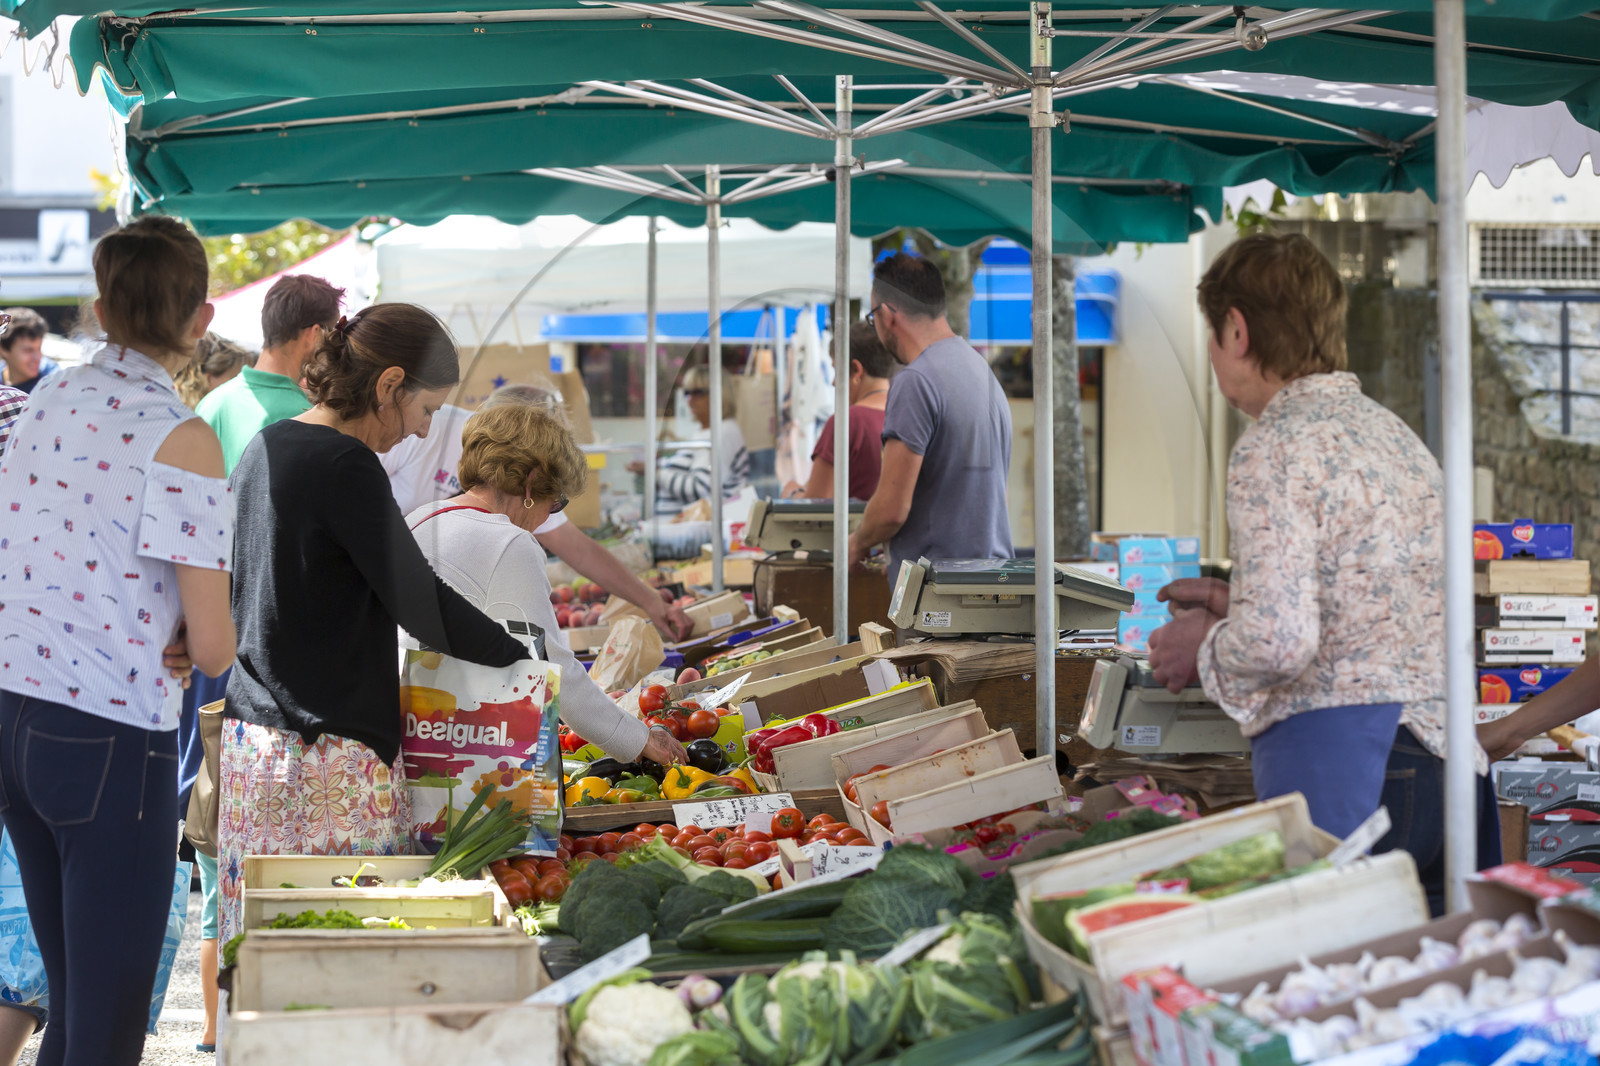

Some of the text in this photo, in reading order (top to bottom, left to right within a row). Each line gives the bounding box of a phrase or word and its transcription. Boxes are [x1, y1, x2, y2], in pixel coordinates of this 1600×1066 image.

[448, 475, 460, 489] Re
[181, 521, 196, 537] B2
[137, 608, 151, 624] B2
[37, 644, 51, 660] B2
